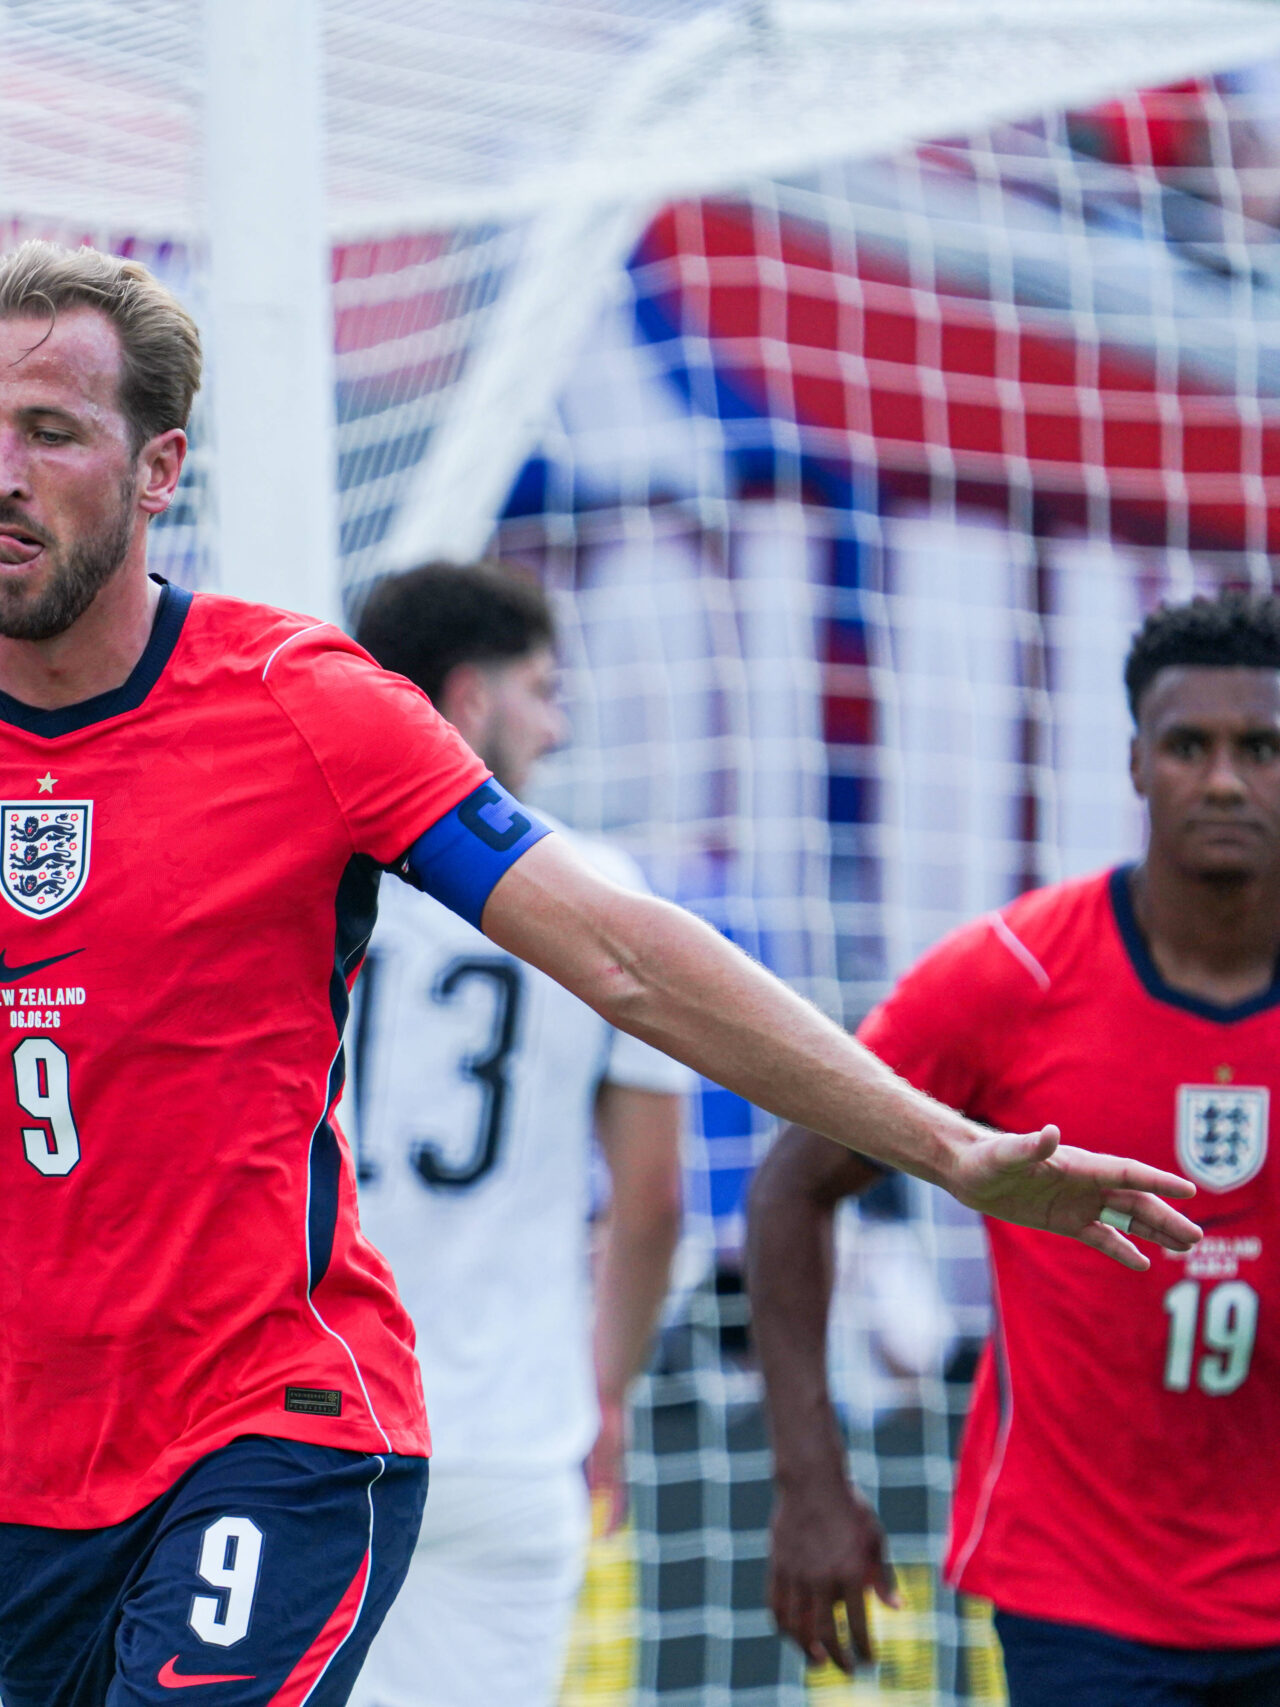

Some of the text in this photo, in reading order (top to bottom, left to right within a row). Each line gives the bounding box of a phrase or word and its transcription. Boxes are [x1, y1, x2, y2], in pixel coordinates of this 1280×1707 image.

[458, 786, 531, 852] C
[10, 1010, 61, 1028] 06.06.26
[19, 987, 86, 1006] ZEALAND
[12, 1037, 81, 1177] 9
[1164, 1280, 1260, 1396] 19
[187, 1515, 265, 1649] 9
